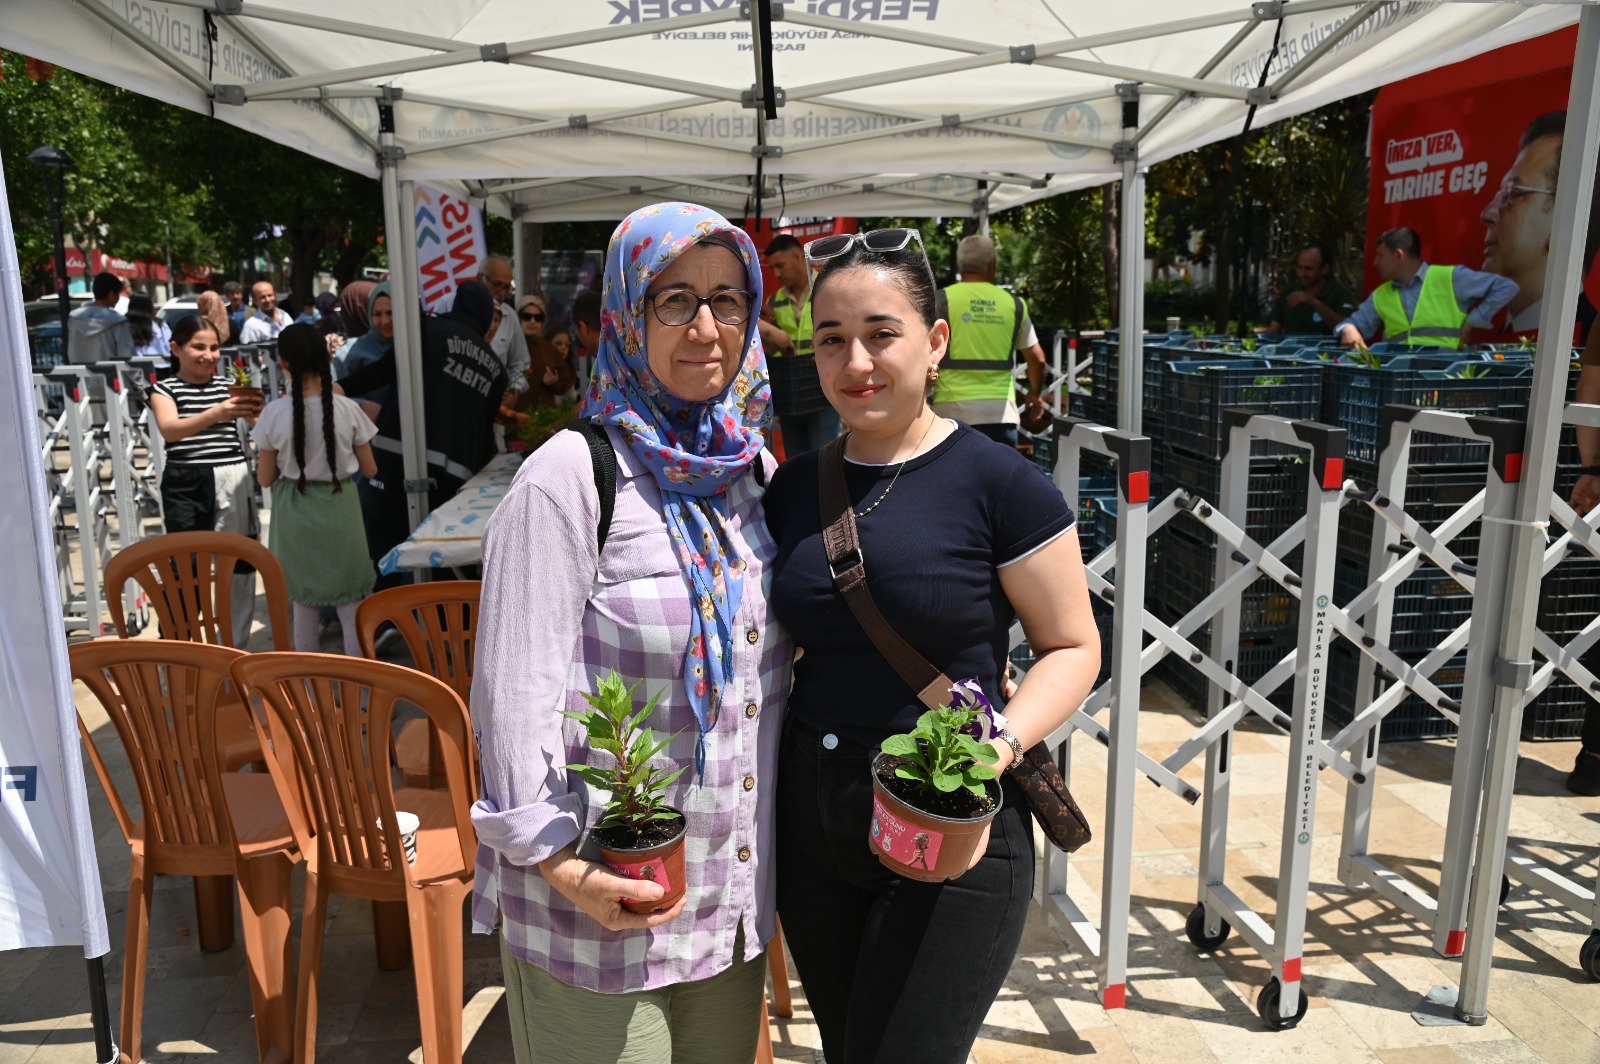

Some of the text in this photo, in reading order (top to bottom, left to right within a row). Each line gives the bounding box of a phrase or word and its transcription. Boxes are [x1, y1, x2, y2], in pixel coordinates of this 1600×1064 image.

[1387, 132, 1458, 164] İMZA VER,
[1448, 160, 1488, 195] GEÇ
[443, 357, 492, 397] ZABITA
[1302, 611, 1326, 831] MANİSA BÜYÜKŞEHİR BELEDİYESİ
